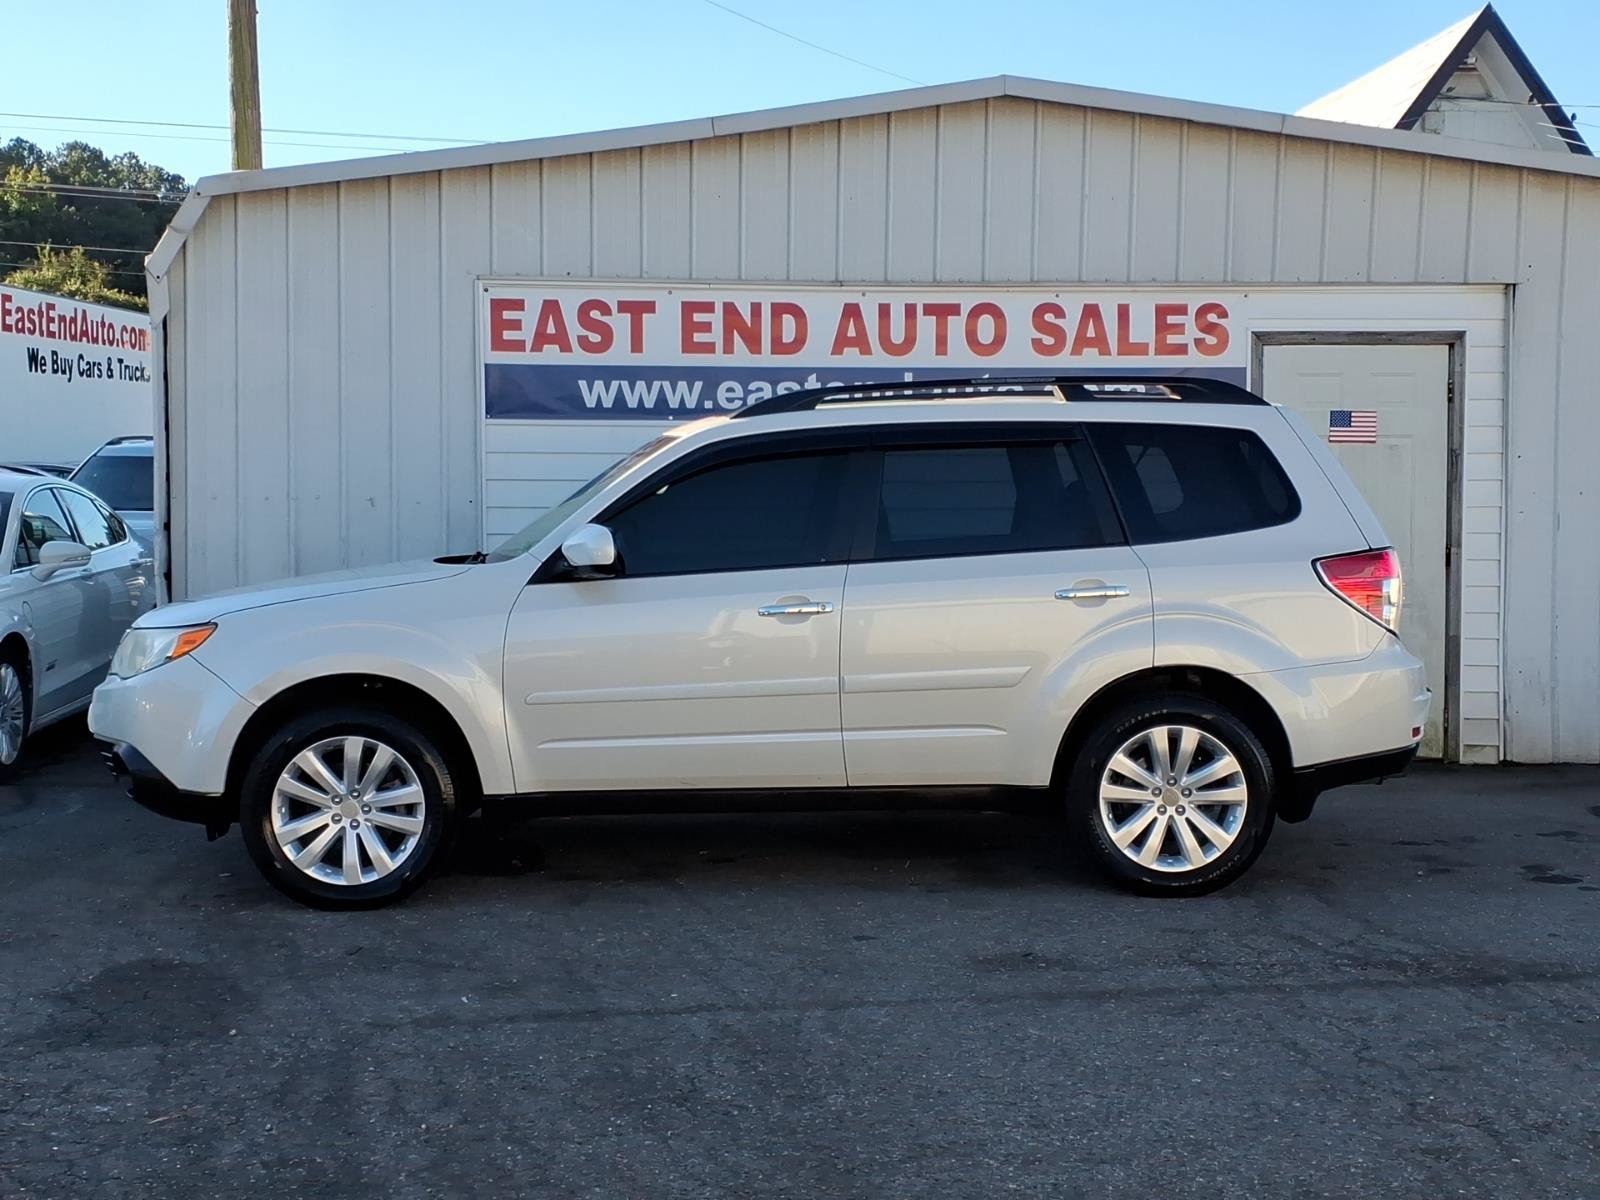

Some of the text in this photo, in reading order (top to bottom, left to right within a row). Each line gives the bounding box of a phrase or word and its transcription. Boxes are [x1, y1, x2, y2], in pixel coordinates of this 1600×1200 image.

[1, 293, 150, 352] EastEndAuto.com
[489, 298, 1230, 357] EAST END AUTO SALES
[26, 346, 47, 374] We
[51, 349, 73, 383] Buy
[77, 353, 103, 379] Cars
[106, 356, 114, 379] &
